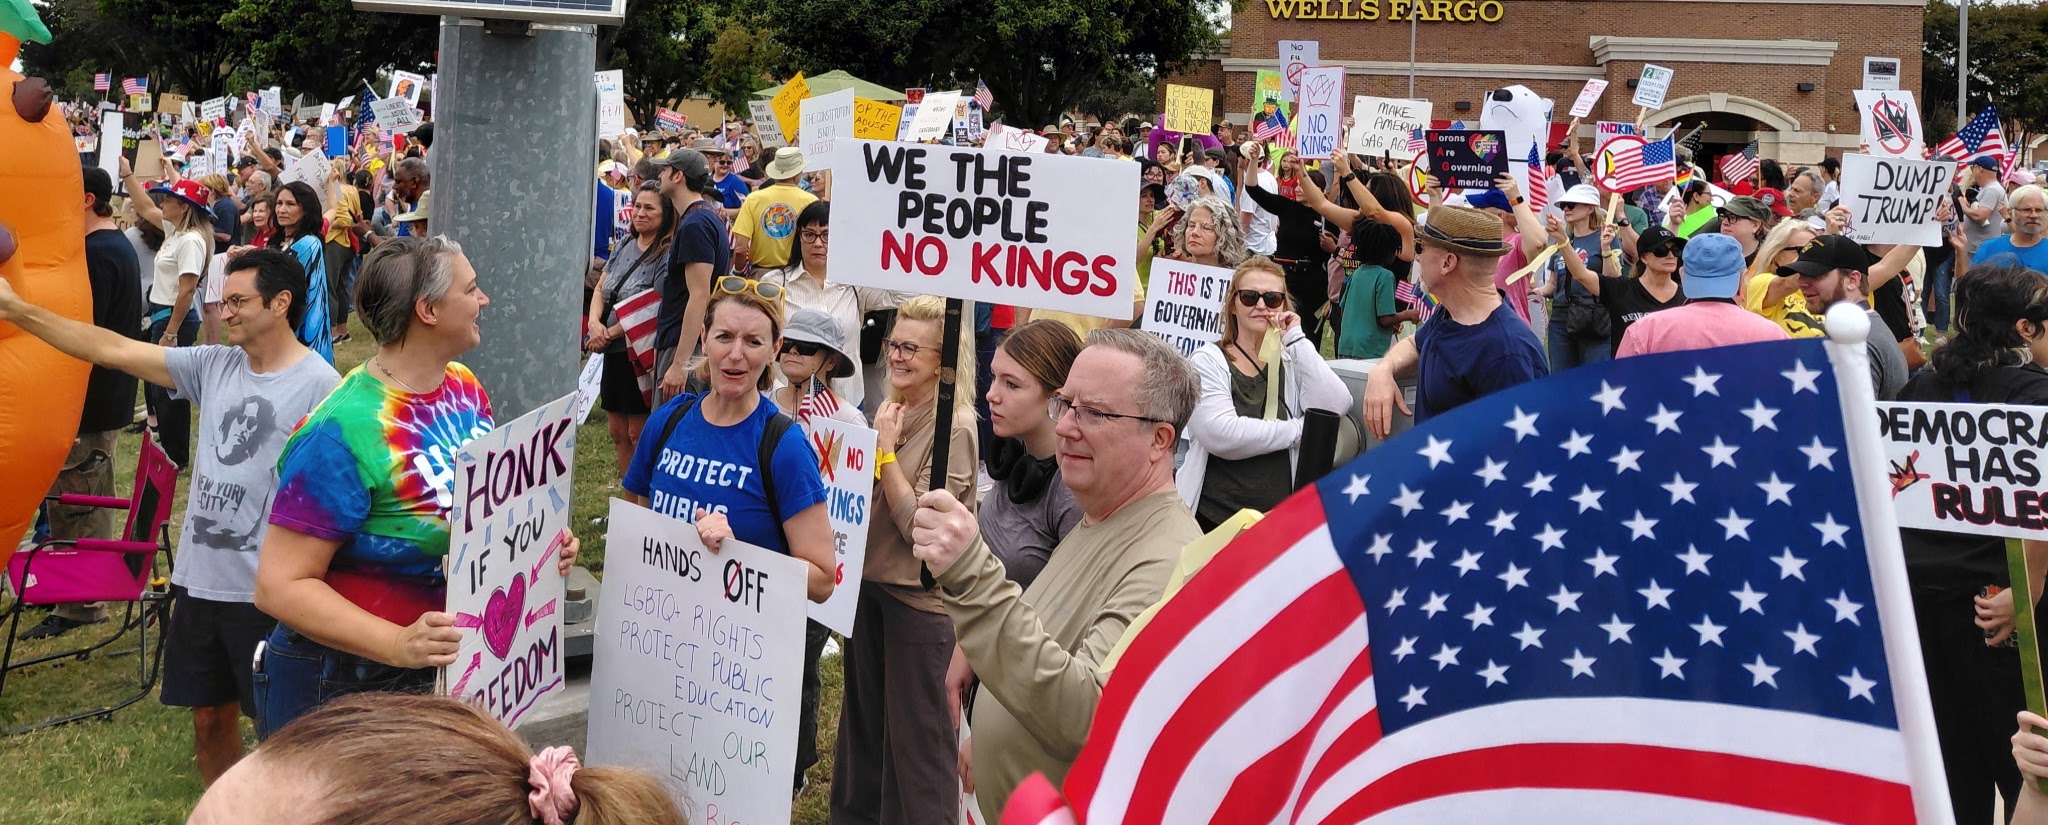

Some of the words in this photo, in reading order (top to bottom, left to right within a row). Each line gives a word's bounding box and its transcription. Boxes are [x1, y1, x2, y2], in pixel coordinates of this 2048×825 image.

[1265, 0, 1380, 21] WELLS
[1388, 0, 1504, 22] FARGO
[1290, 43, 1304, 51] NO
[792, 80, 804, 94] THE
[1172, 86, 1204, 100] 8647
[854, 100, 873, 115] OP
[876, 108, 898, 123] THE
[1167, 98, 1179, 108] NO
[1186, 100, 1207, 111] KINGS
[1167, 108, 1179, 118] NO
[1377, 102, 1416, 119] MAKE
[805, 112, 816, 125] THE
[855, 117, 890, 132] ABUSE
[1166, 118, 1178, 129] NO
[1184, 119, 1210, 133] NAZIS
[1307, 113, 1328, 135] NO
[1600, 123, 1618, 134] NO
[809, 139, 836, 156] SUGGESTI
[1300, 135, 1334, 156] KINGS
[1361, 131, 1383, 148] GAG
[1429, 132, 1466, 143] Morons
[862, 143, 927, 190] WE
[950, 152, 1032, 199] THE
[1441, 161, 1493, 174] Governing
[1873, 161, 1947, 195] DUMP
[1447, 178, 1489, 187] America
[898, 190, 1049, 243] PEOPLE
[1858, 194, 1945, 225] TRUMP!
[880, 229, 948, 276] NO
[971, 241, 1117, 297] KINGS
[1167, 271, 1197, 297] THIS
[1200, 276, 1214, 300] IS
[1154, 299, 1226, 335] GOVERNME
[656, 447, 753, 490] PROTECT
[846, 445, 864, 471] NO
[1944, 446, 2041, 487] HAS
[464, 417, 571, 534] HONK
[199, 492, 228, 512] CITY
[470, 548, 491, 595] IF
[503, 508, 544, 563] YOU
[642, 536, 702, 582] HANDS
[723, 559, 768, 613] OFF
[623, 583, 681, 621] LGBTQ+
[692, 605, 765, 660] RIGHTS
[466, 625, 558, 720] REEDOM
[620, 620, 699, 672] PROTECT
[712, 652, 775, 702] PUBLIC
[675, 675, 775, 729] EDUCATION
[614, 688, 703, 744] PROTECT
[723, 731, 770, 775] OUR
[670, 743, 727, 796] LAND
